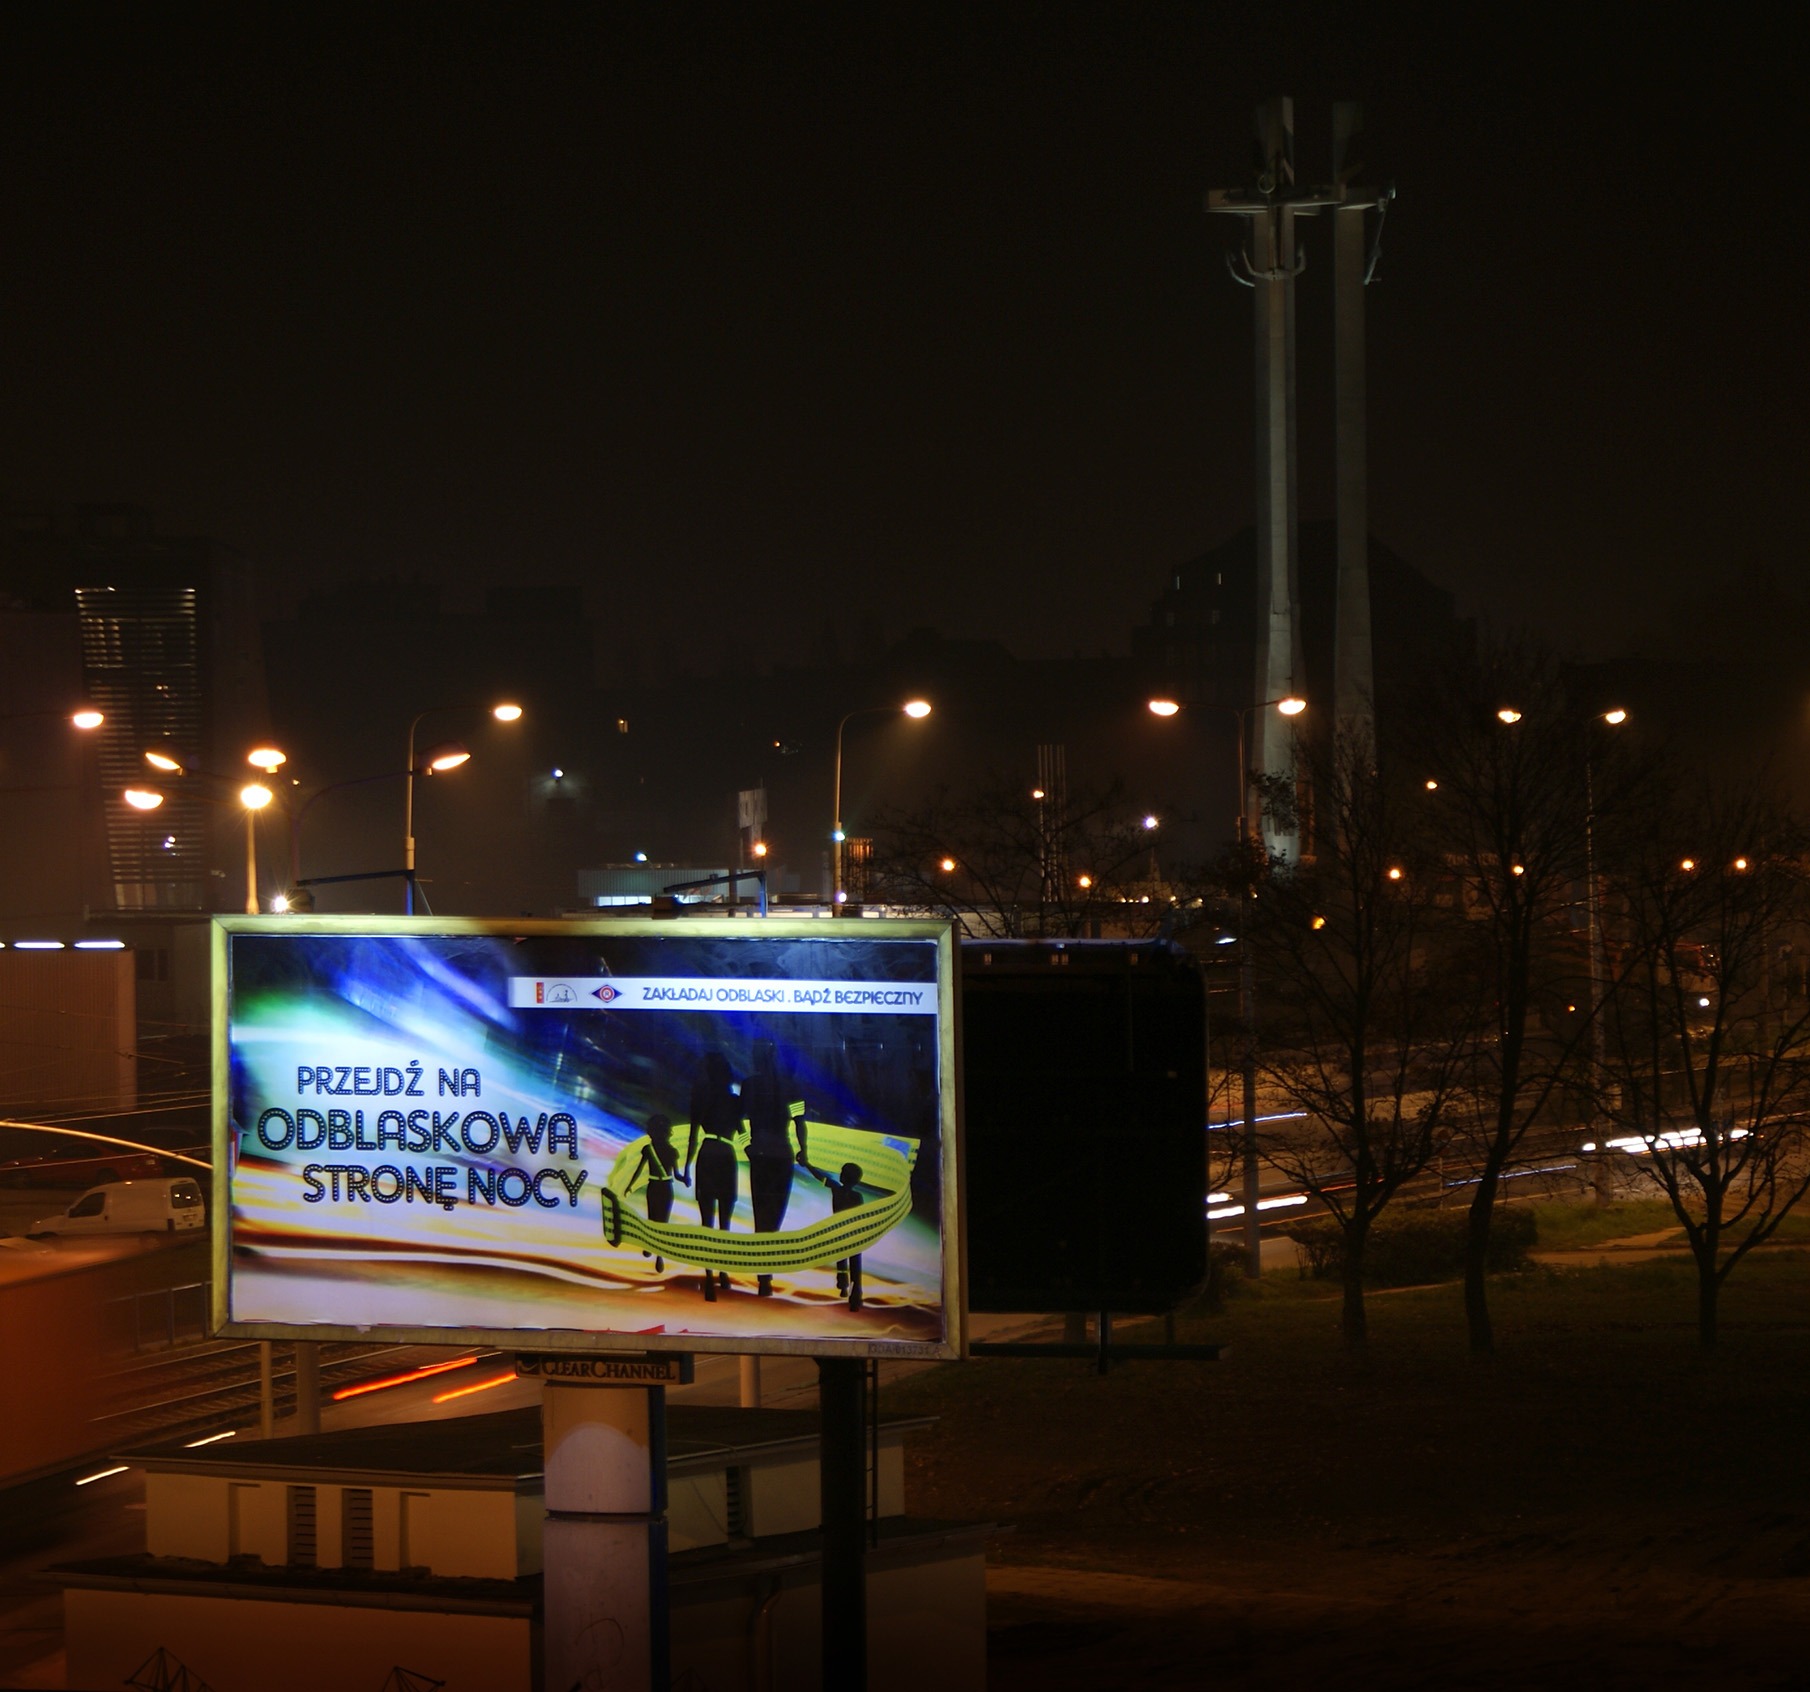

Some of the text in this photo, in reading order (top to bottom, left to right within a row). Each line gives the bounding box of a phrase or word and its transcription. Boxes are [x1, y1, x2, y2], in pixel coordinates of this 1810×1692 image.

[643, 987, 713, 1001] ZAKŁADAJ
[793, 988, 831, 1006] BĄDŹ
[834, 990, 923, 1005] BEZPIECZNY
[298, 1060, 481, 1097] PRZEJDŹ NA
[257, 1107, 578, 1160] ODBLASKOWĄ
[302, 1163, 589, 1211] STRONĘ NOCY
